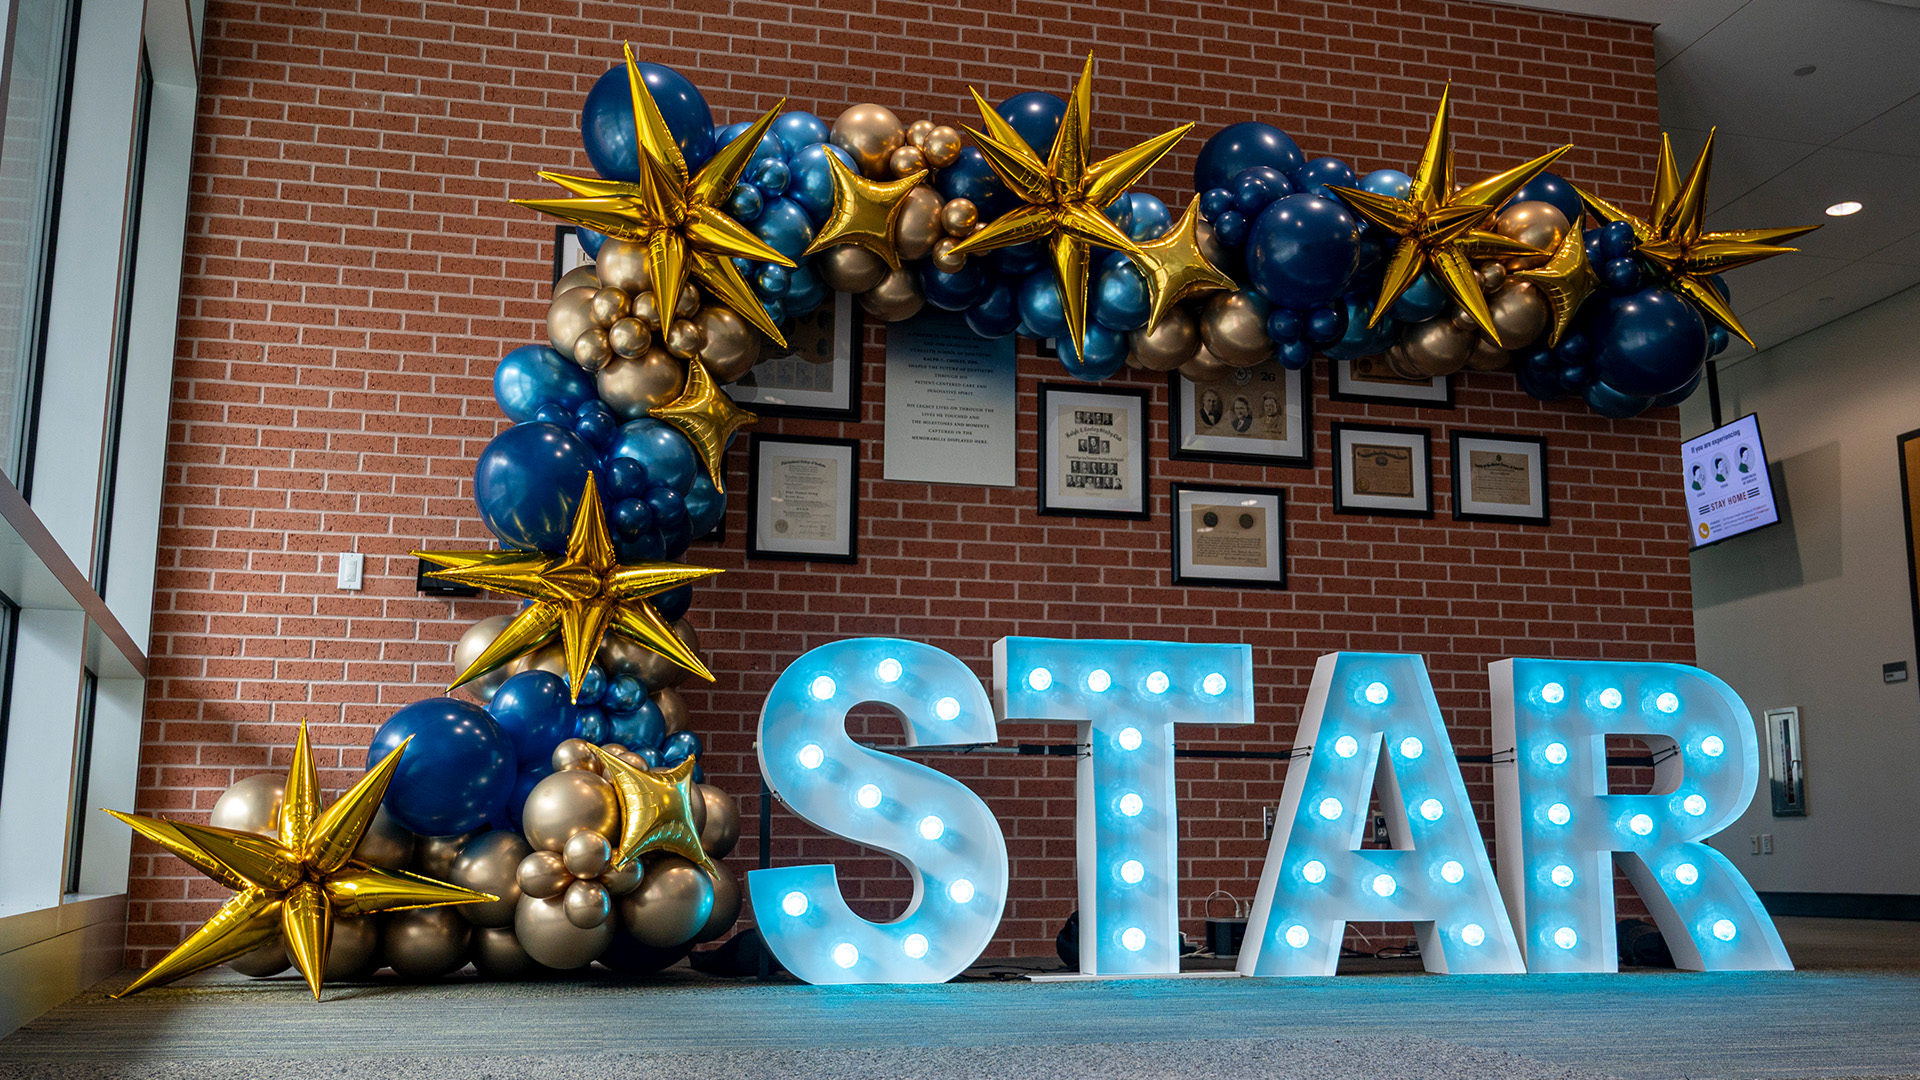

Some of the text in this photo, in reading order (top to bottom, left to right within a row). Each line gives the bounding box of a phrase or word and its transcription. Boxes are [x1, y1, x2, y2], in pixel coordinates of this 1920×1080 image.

[1261, 372, 1275, 381] 26
[1712, 430, 1740, 445] experiencing
[1711, 492, 1747, 511] STAY HOME
[748, 636, 1794, 984] STAR
